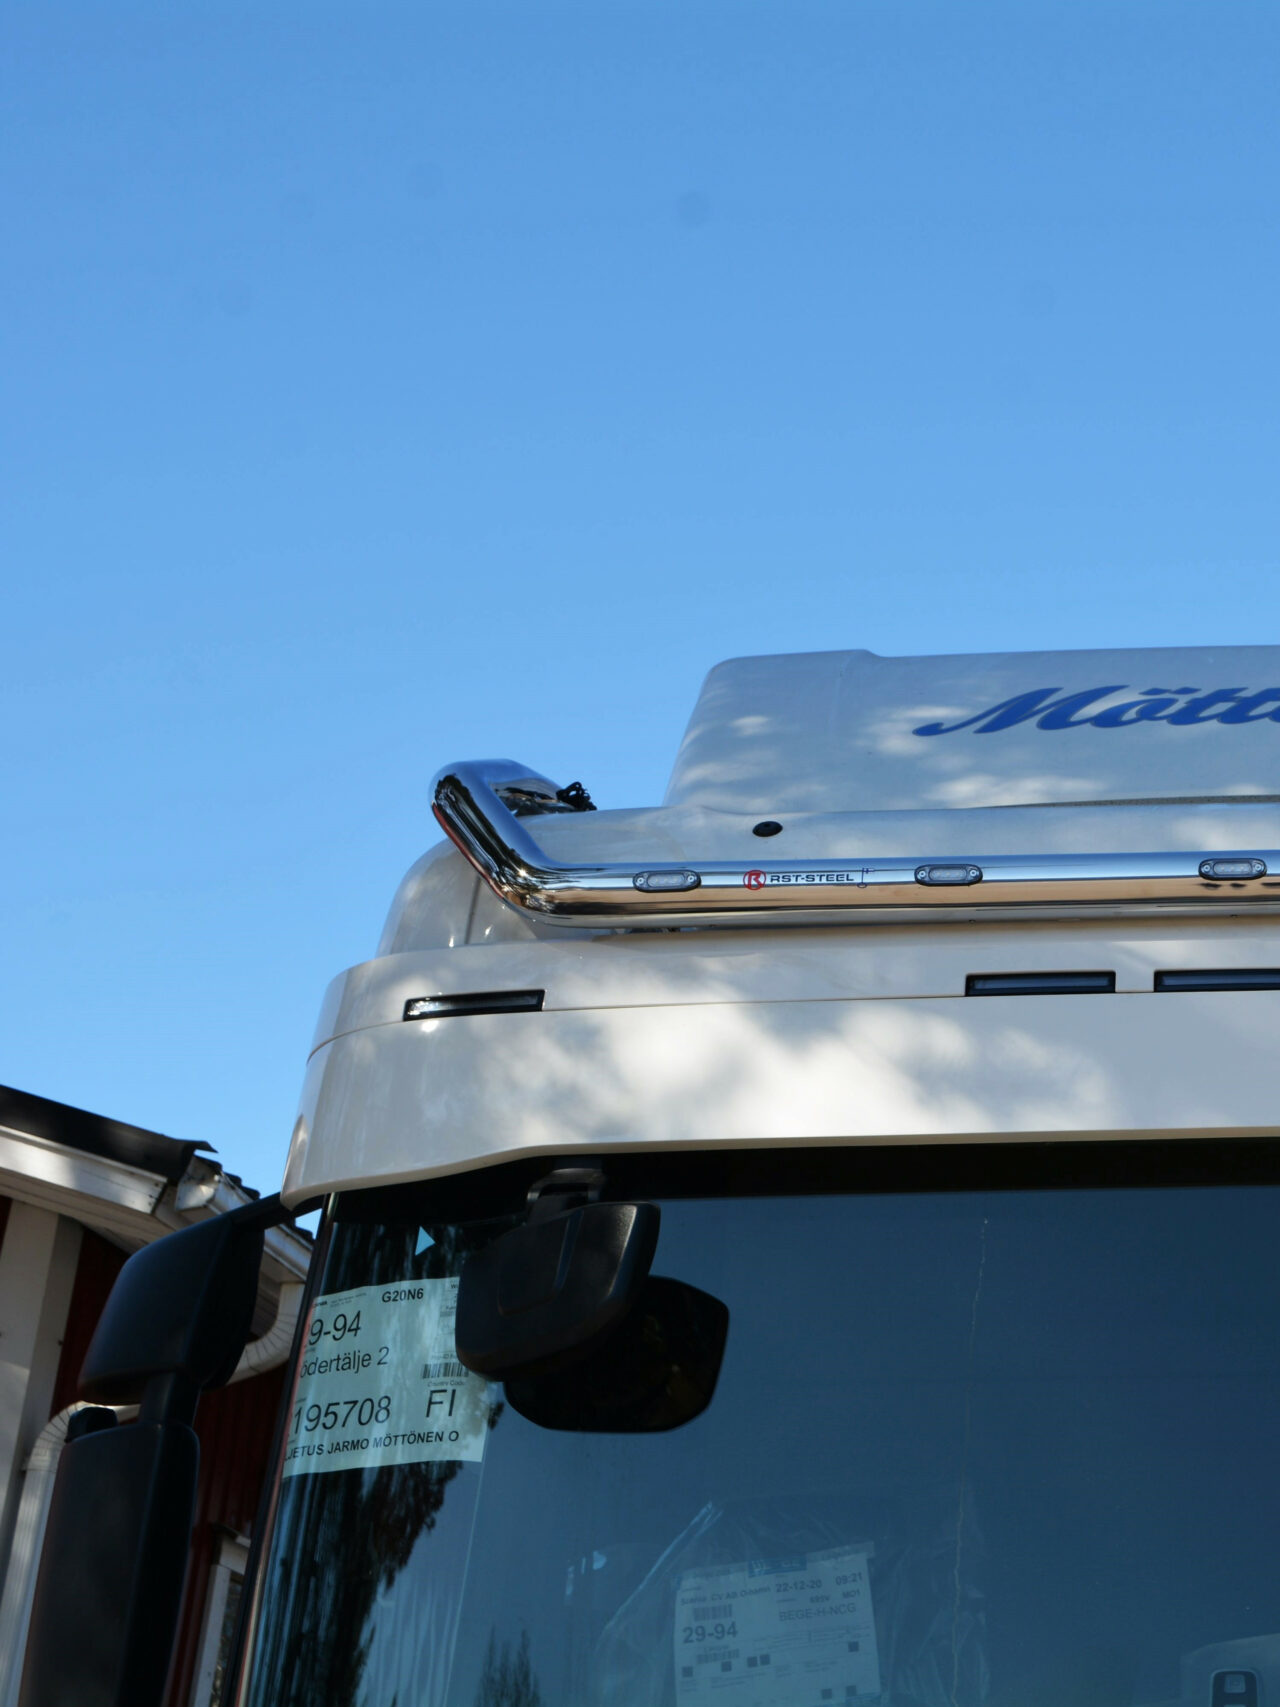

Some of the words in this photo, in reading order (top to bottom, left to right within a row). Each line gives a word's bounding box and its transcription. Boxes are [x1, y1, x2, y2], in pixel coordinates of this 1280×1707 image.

[770, 873, 855, 883] RST-STEEL
[381, 1287, 424, 1303] G20N6
[377, 1346, 390, 1366] 2
[425, 1388, 457, 1418] FI
[327, 1438, 370, 1455] JARMO
[372, 1430, 445, 1450] MÖTTÖNEN
[448, 1430, 460, 1442] O
[682, 1621, 739, 1645] 29-94
